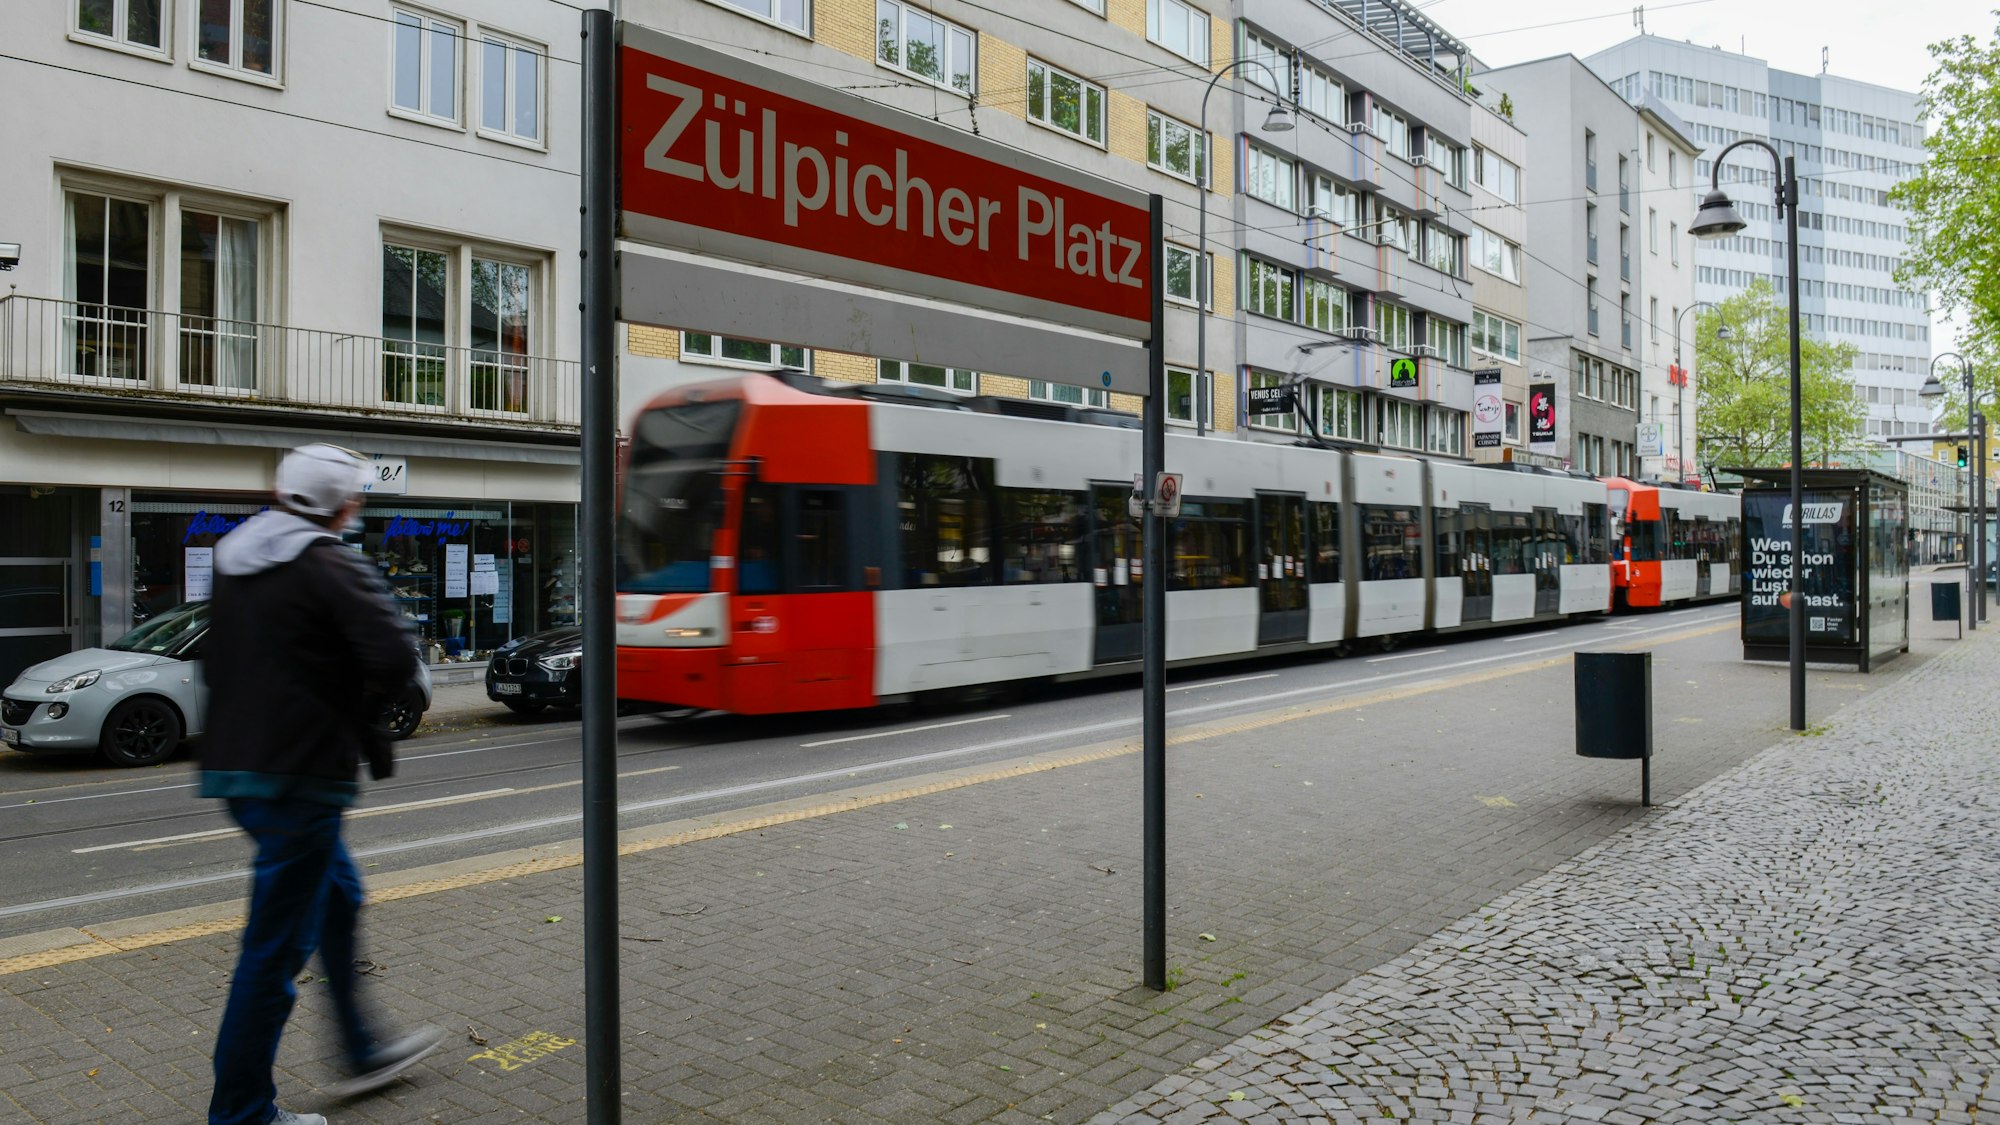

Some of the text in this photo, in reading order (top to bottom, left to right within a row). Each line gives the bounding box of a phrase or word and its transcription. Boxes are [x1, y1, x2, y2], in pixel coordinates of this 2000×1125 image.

[644, 72, 1142, 288] Zülpicher Platz
[1250, 390, 1269, 400] VENUS
[109, 500, 124, 513] 12
[383, 514, 435, 545] follow
[1752, 551, 1834, 565] Du shon
[1752, 564, 1812, 579] wiedr
[1752, 579, 1789, 592] Lust
[1752, 592, 1779, 606] auf
